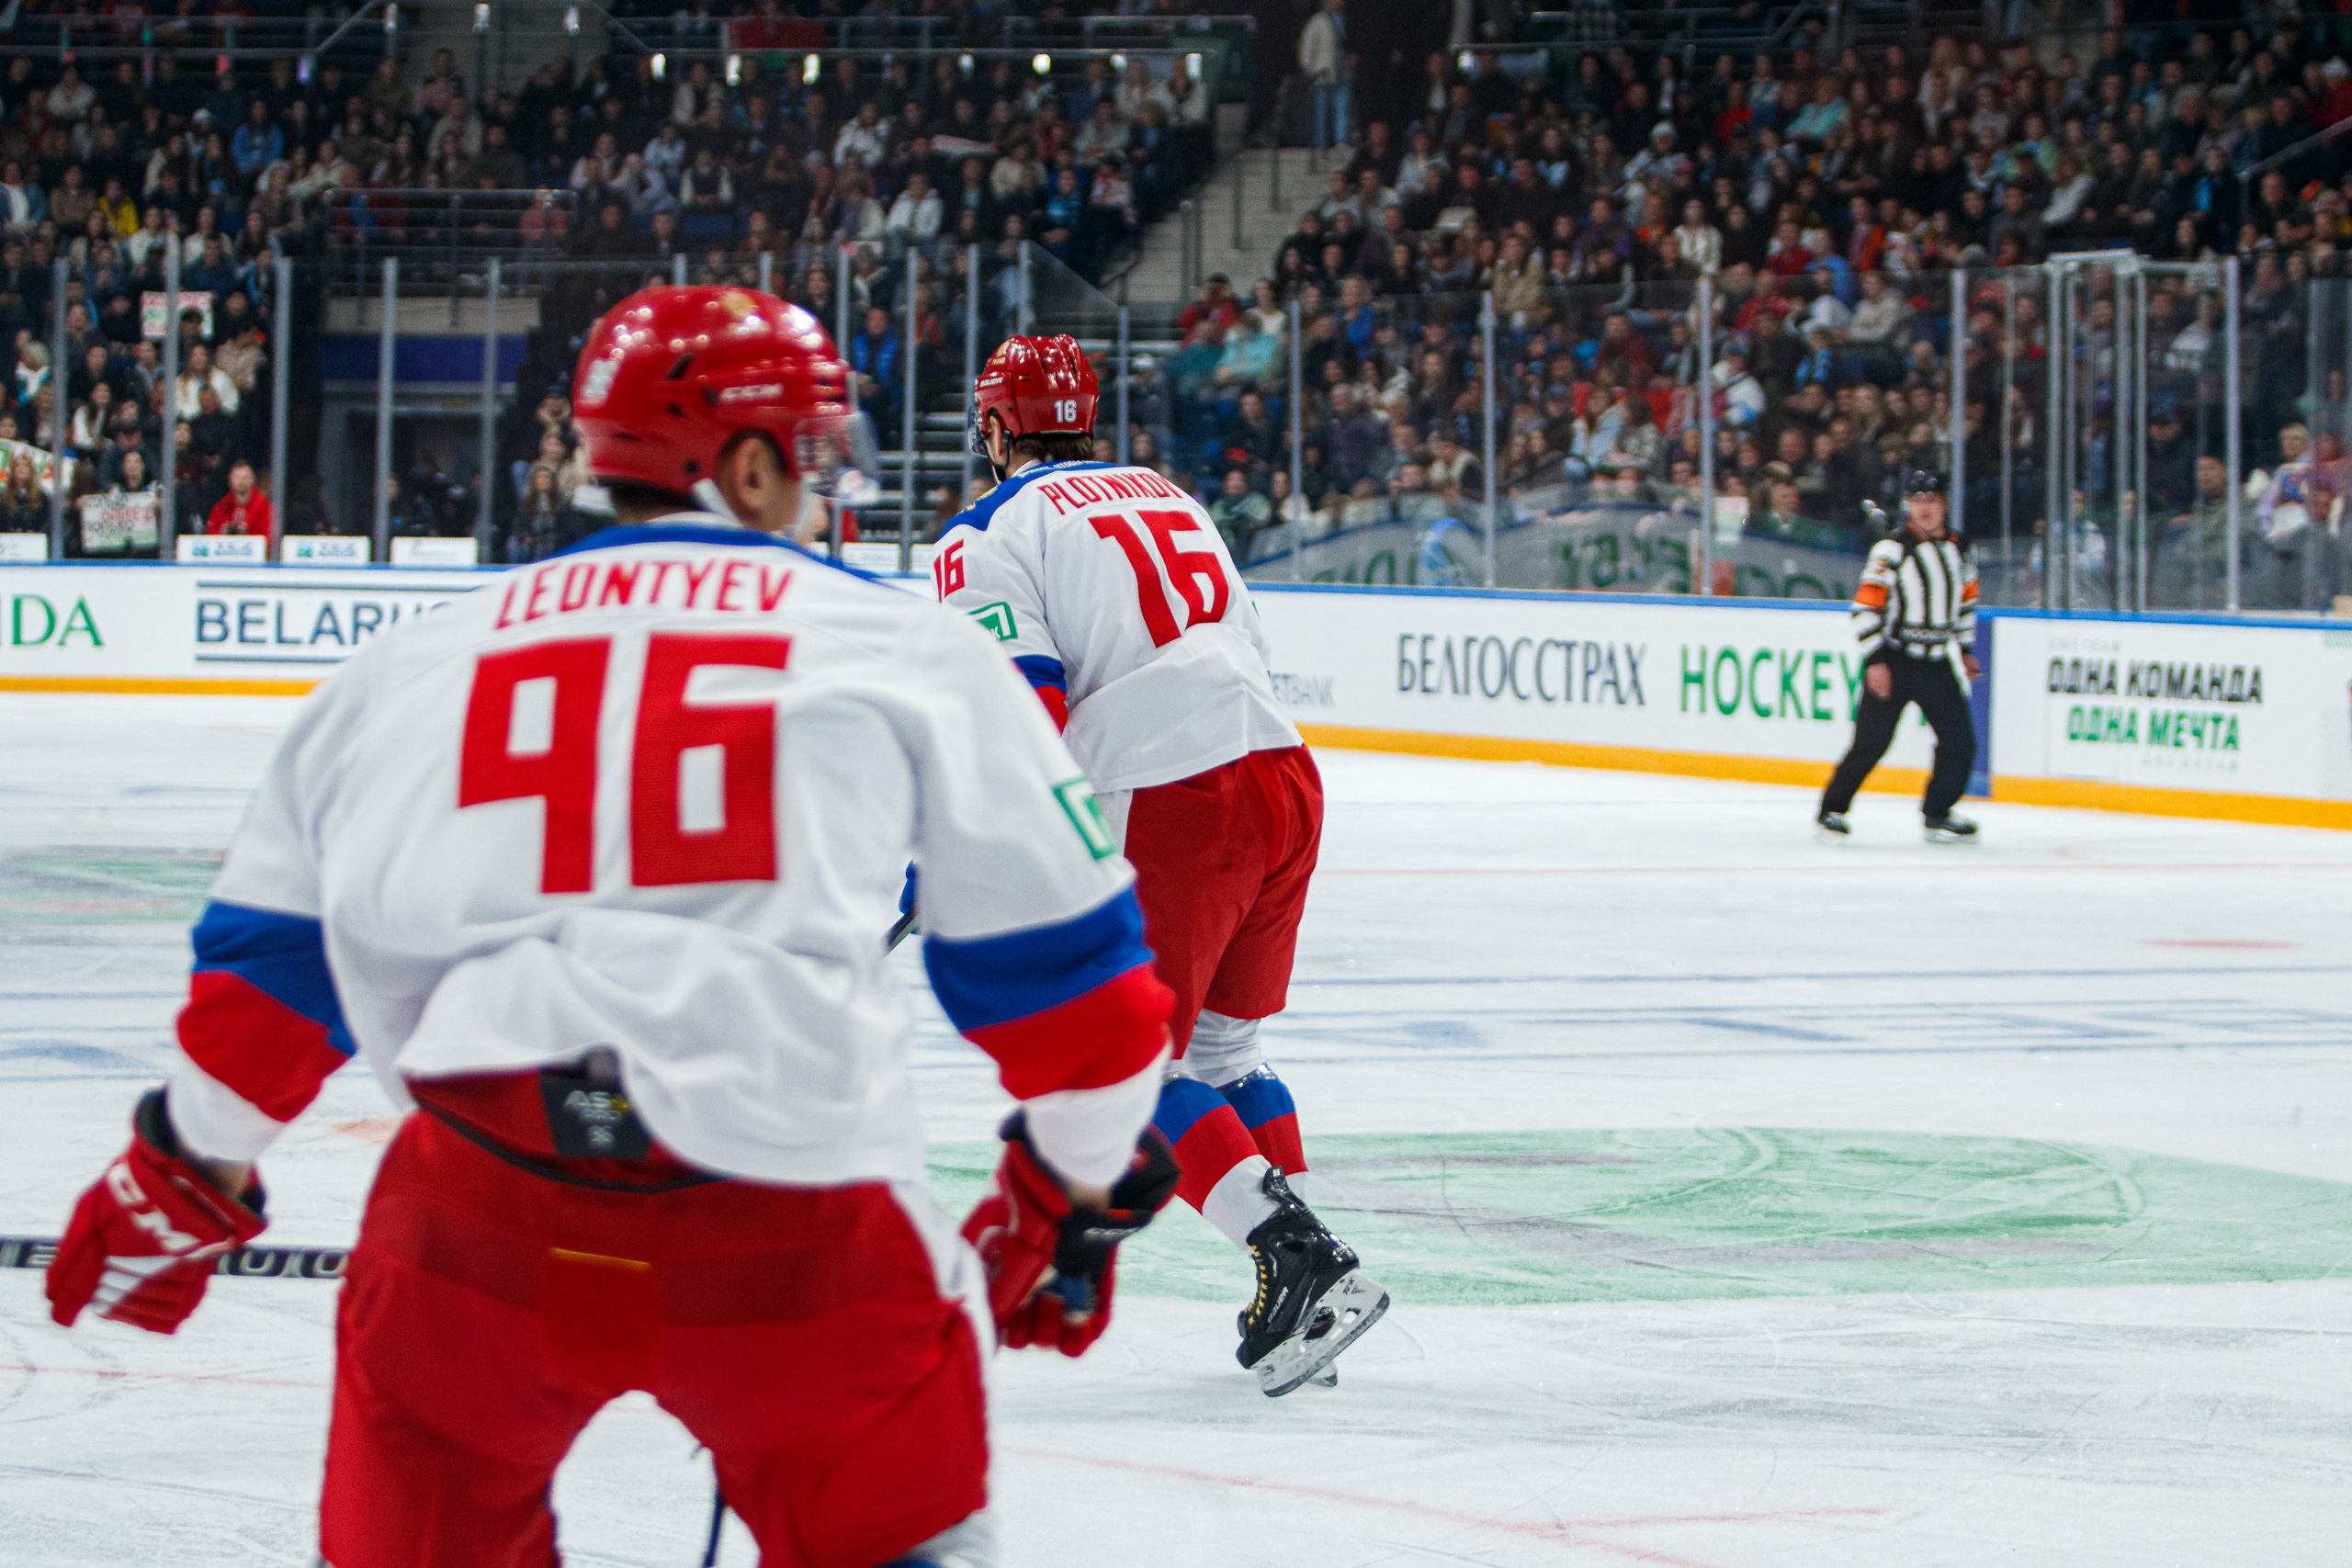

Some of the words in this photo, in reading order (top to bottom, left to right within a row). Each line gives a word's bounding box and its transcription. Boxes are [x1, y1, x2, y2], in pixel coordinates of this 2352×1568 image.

[1054, 399, 1078, 423] 16
[1037, 472, 1183, 515] PLOTNIKOV
[493, 557, 794, 631] LEONTYEV
[933, 538, 966, 604] 16
[1088, 509, 1229, 649] 16
[0, 593, 105, 646] DA
[195, 599, 448, 645] BELAR
[1397, 631, 1647, 706] БЕЛГОССТРАХ
[2048, 656, 2118, 694] ОДНА
[2127, 660, 2263, 704] КОМАНДА
[2069, 705, 2138, 743] ОДНА
[2148, 708, 2240, 751] МЕЧТА
[457, 631, 795, 897] 96
